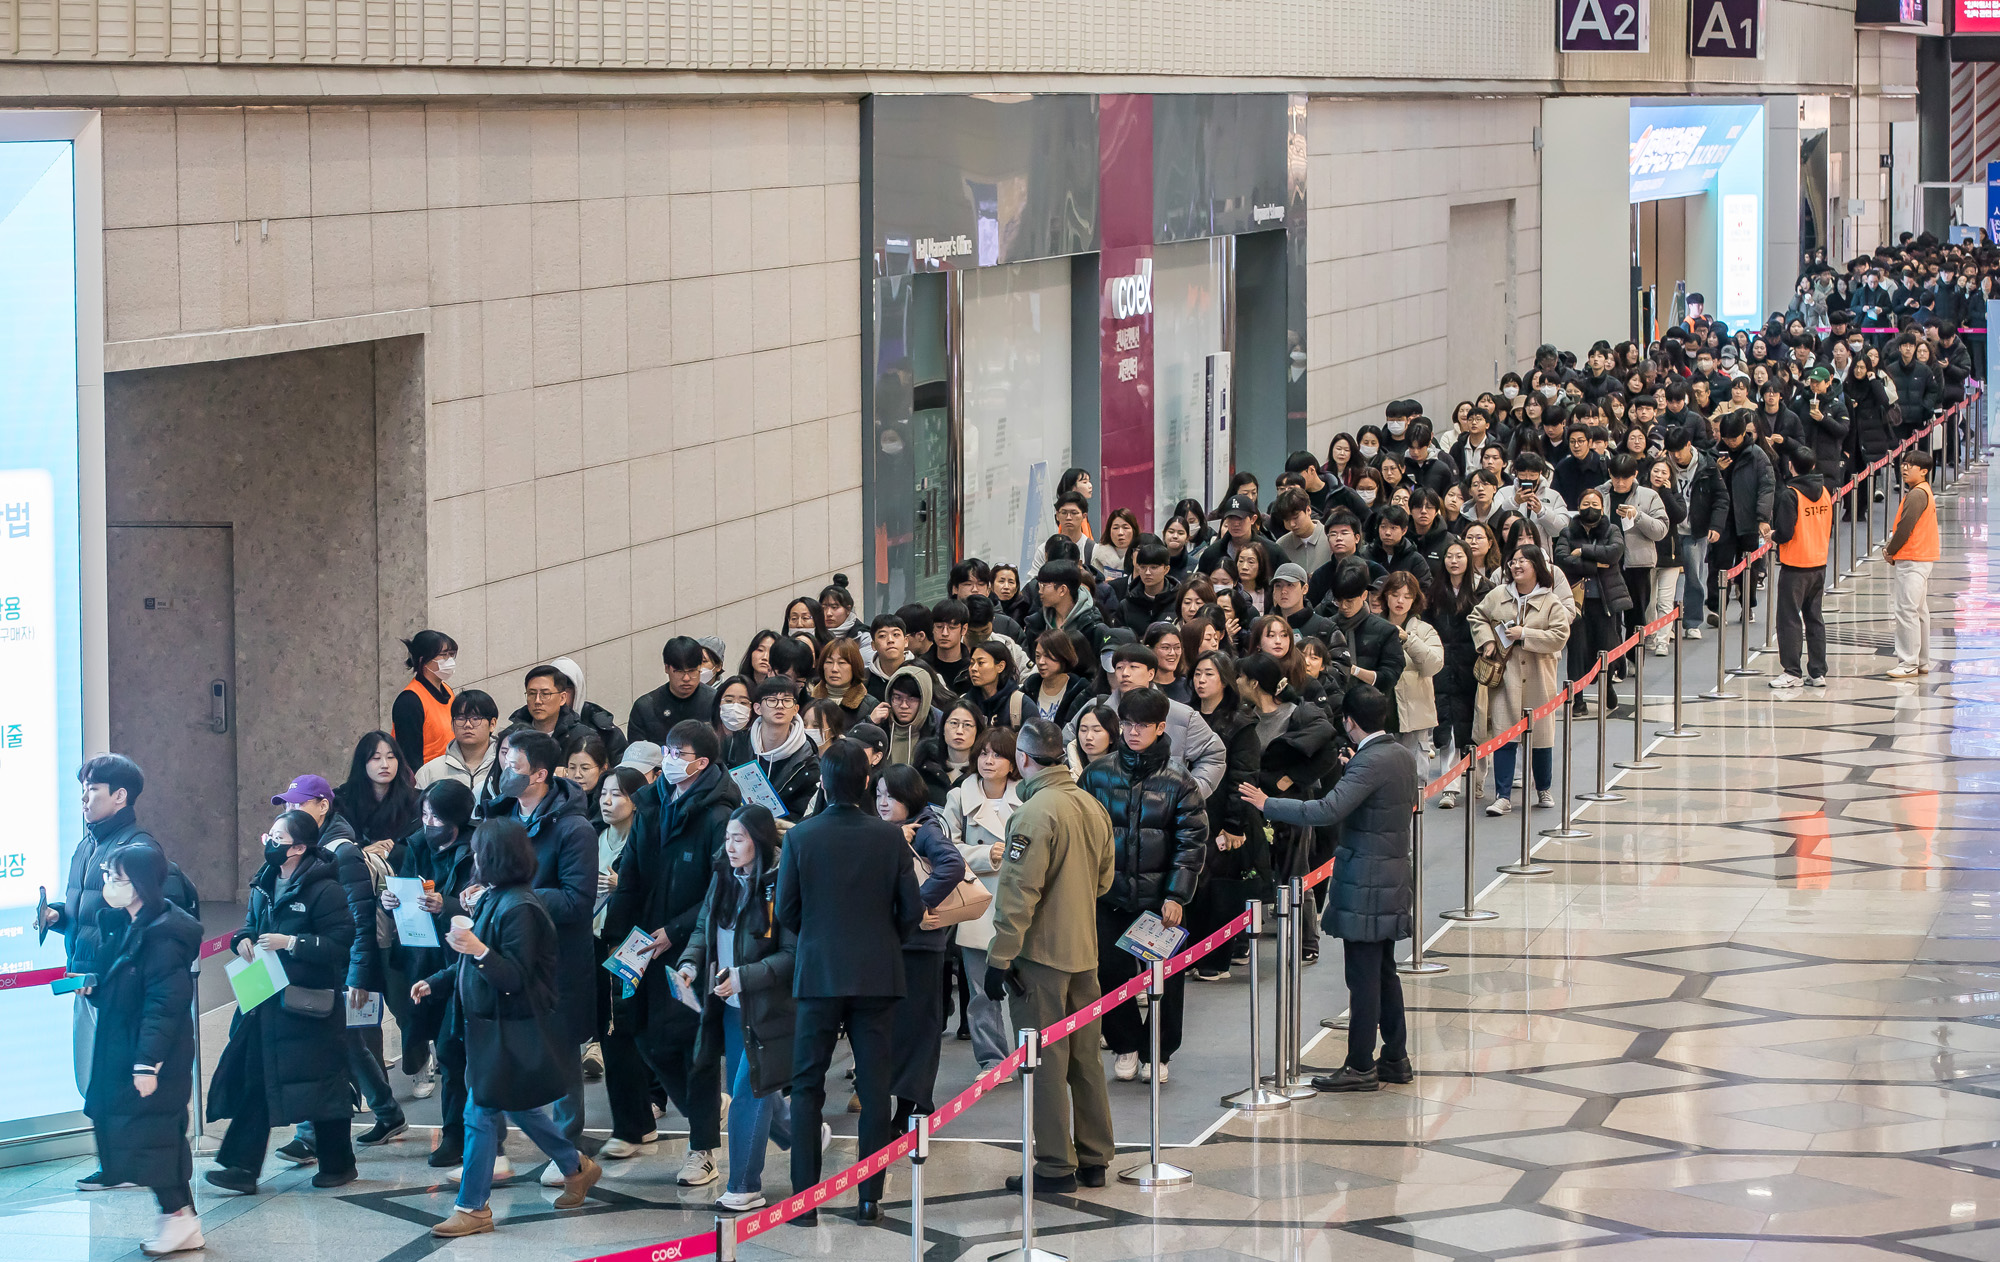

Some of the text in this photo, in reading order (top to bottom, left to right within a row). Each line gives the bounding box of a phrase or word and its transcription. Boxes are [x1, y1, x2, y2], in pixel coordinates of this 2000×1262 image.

[1566, 0, 1635, 41] A2
[1697, 1, 1752, 49] A1
[916, 234, 973, 262] Hall Manager's Office
[1114, 258, 1152, 320] coex
[0, 502, 30, 539] 법
[1805, 505, 1828, 517] STAFF
[0, 596, 21, 621] 용
[212, 937, 223, 951] coex
[1118, 985, 1128, 1001] coex
[1092, 1001, 1102, 1017] coex
[1066, 1016, 1076, 1032] coex
[1041, 1029, 1049, 1045] oex
[993, 1066, 1002, 1083] coex
[974, 1081, 983, 1099] coex
[953, 1096, 963, 1114] coex
[932, 1111, 942, 1129] coex
[897, 1136, 909, 1155] coex
[877, 1148, 890, 1168] coex
[857, 1160, 870, 1180] coex
[835, 1172, 849, 1191] coex
[814, 1182, 827, 1202] coex
[791, 1193, 805, 1213] coex
[746, 1213, 761, 1234] coex
[769, 1203, 783, 1224] coex
[651, 1241, 683, 1262] coex
